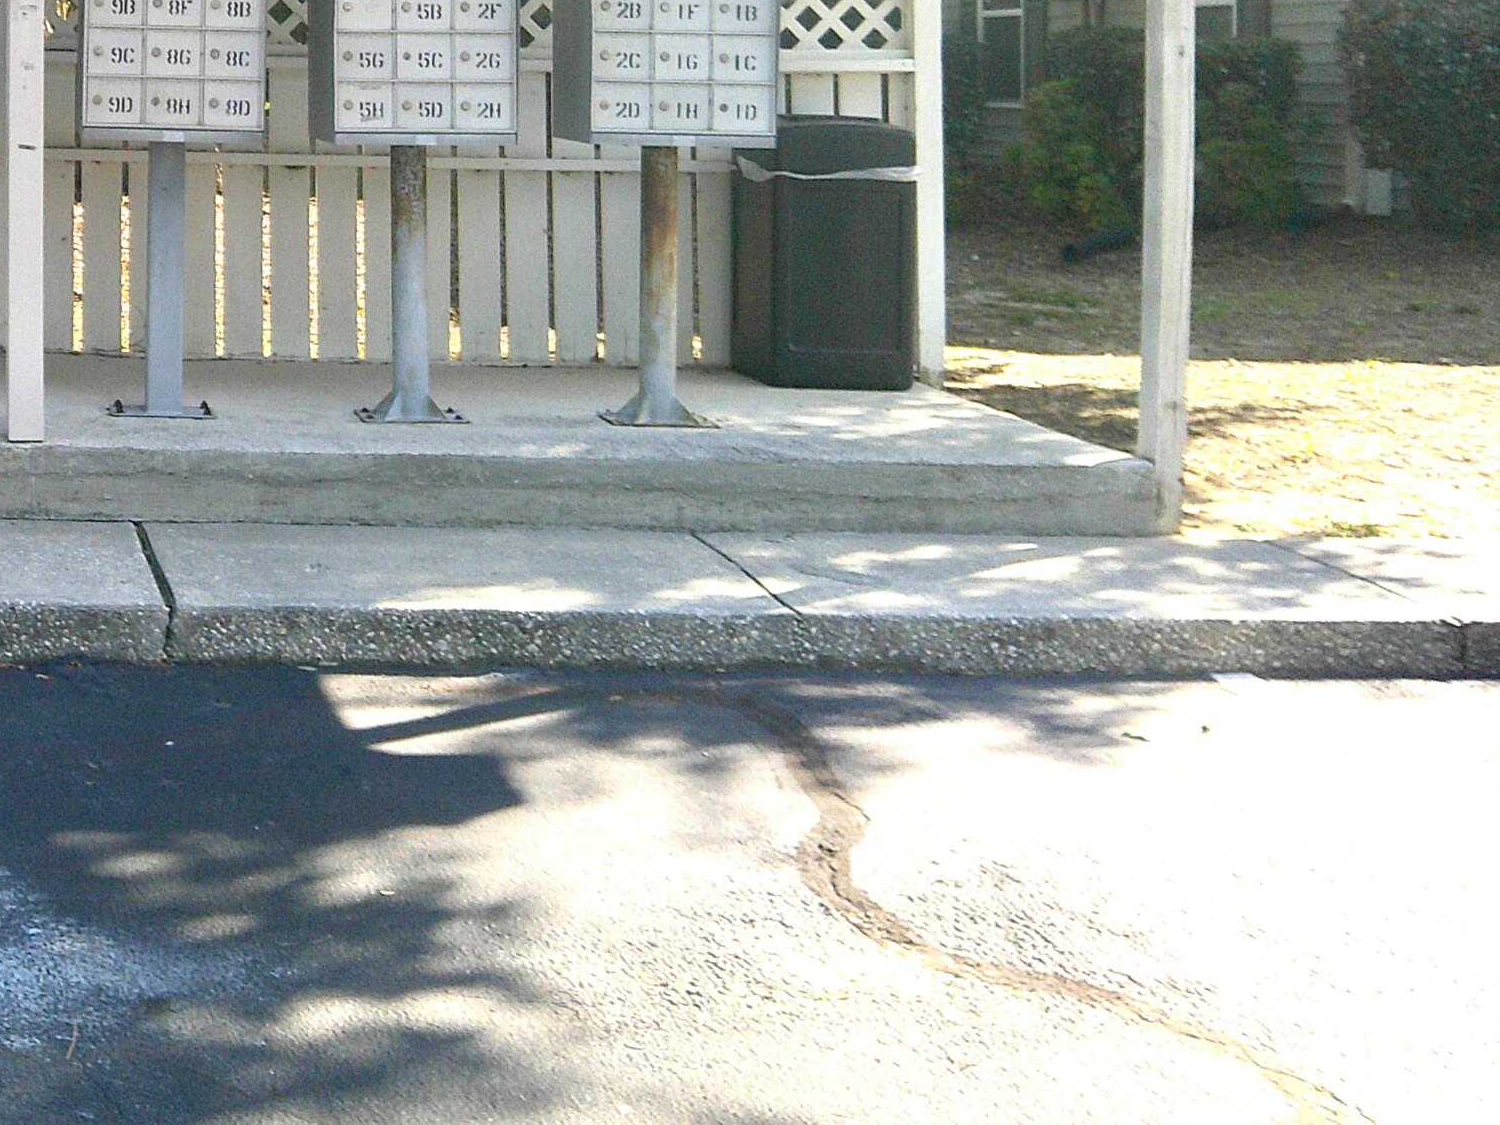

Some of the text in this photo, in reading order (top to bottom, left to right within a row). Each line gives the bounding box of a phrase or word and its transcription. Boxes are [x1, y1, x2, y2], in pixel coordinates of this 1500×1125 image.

[112, 0, 135, 14] 9B
[169, 0, 192, 15] 8F
[227, 2, 250, 17] 8B
[418, 4, 441, 19] 5B
[478, 3, 502, 19] 2F
[617, 2, 641, 18] 2B
[679, 4, 699, 19] 1F
[737, 5, 757, 21] 1B
[112, 48, 134, 63] 9C
[168, 49, 190, 64] 8G
[227, 51, 249, 66] 8C
[360, 53, 383, 68] 5G
[419, 53, 442, 68] 5C
[476, 53, 500, 68] 2G
[616, 52, 640, 68] 2C
[678, 54, 697, 69] 1G
[735, 55, 756, 70] 1C
[109, 97, 132, 112] 9D
[167, 99, 190, 114] 8H
[226, 100, 250, 116] 8D
[360, 102, 383, 117] 5H
[419, 102, 442, 118] 5D
[478, 103, 500, 118] 2H
[616, 103, 639, 118] 2D
[677, 103, 697, 119] 1H
[737, 104, 756, 120] 1D
